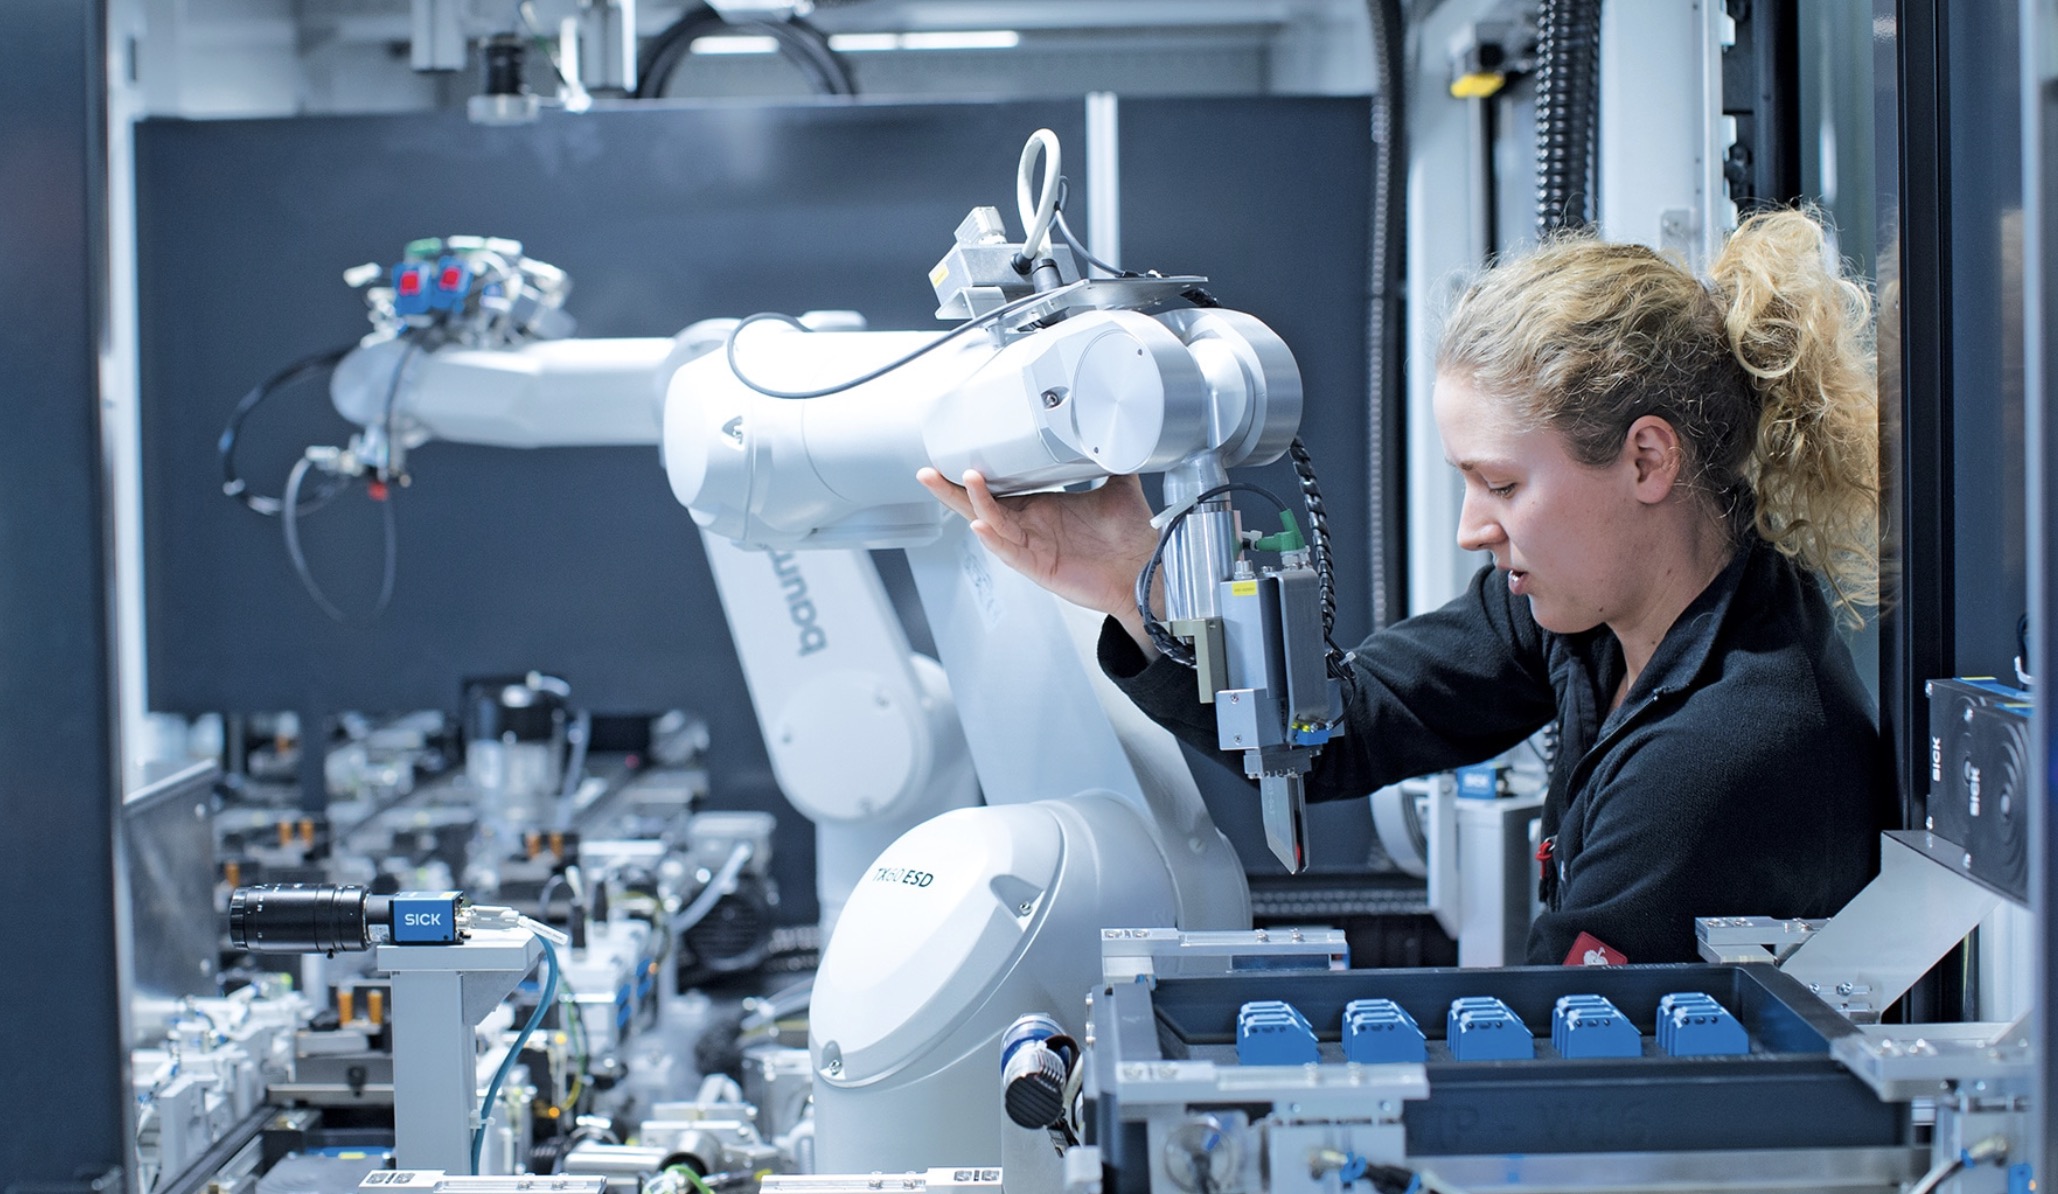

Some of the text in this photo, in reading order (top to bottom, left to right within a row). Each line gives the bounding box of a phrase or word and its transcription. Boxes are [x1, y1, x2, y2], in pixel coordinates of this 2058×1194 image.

[1931, 736, 1941, 782] SICK
[902, 869, 934, 887] ESD
[404, 912, 441, 926] SICK
